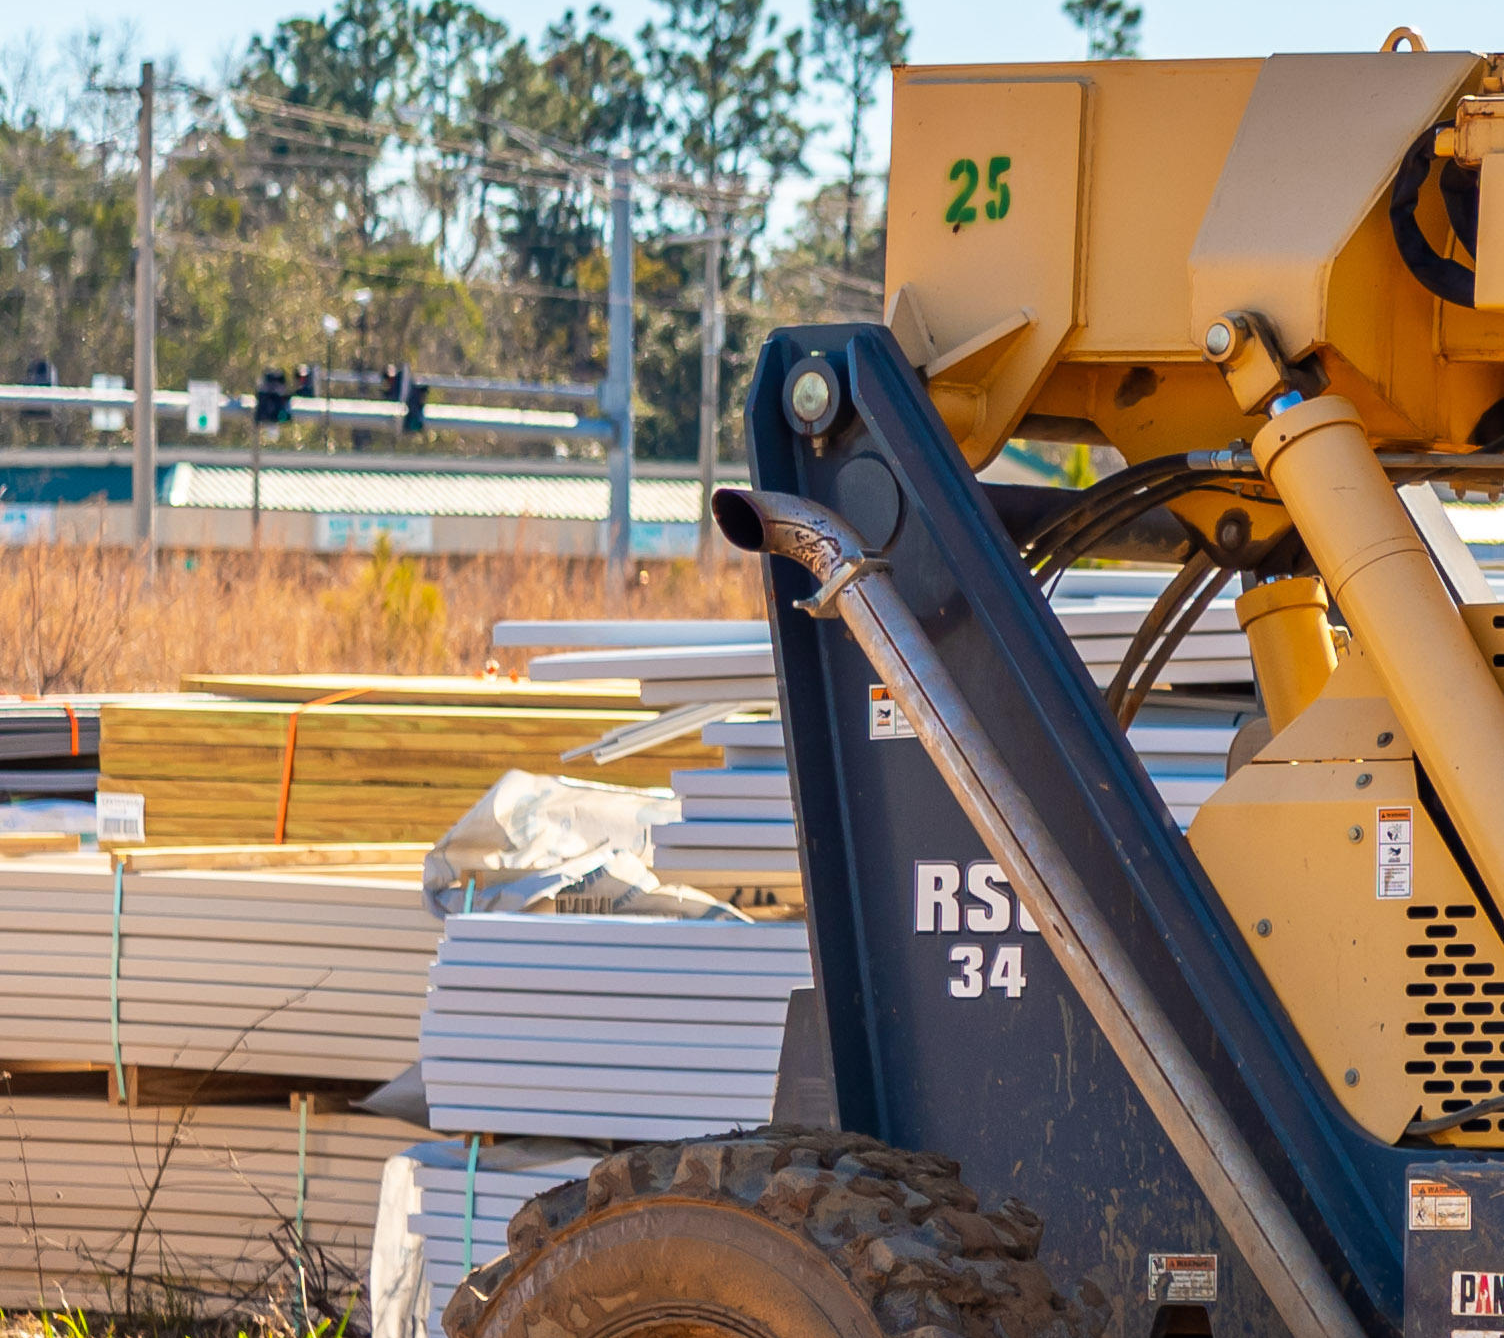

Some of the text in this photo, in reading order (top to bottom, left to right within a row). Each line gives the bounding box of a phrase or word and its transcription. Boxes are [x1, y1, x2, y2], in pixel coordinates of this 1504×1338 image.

[945, 155, 1012, 224] 25
[914, 860, 1041, 934] RS
[948, 943, 1028, 999] 34
